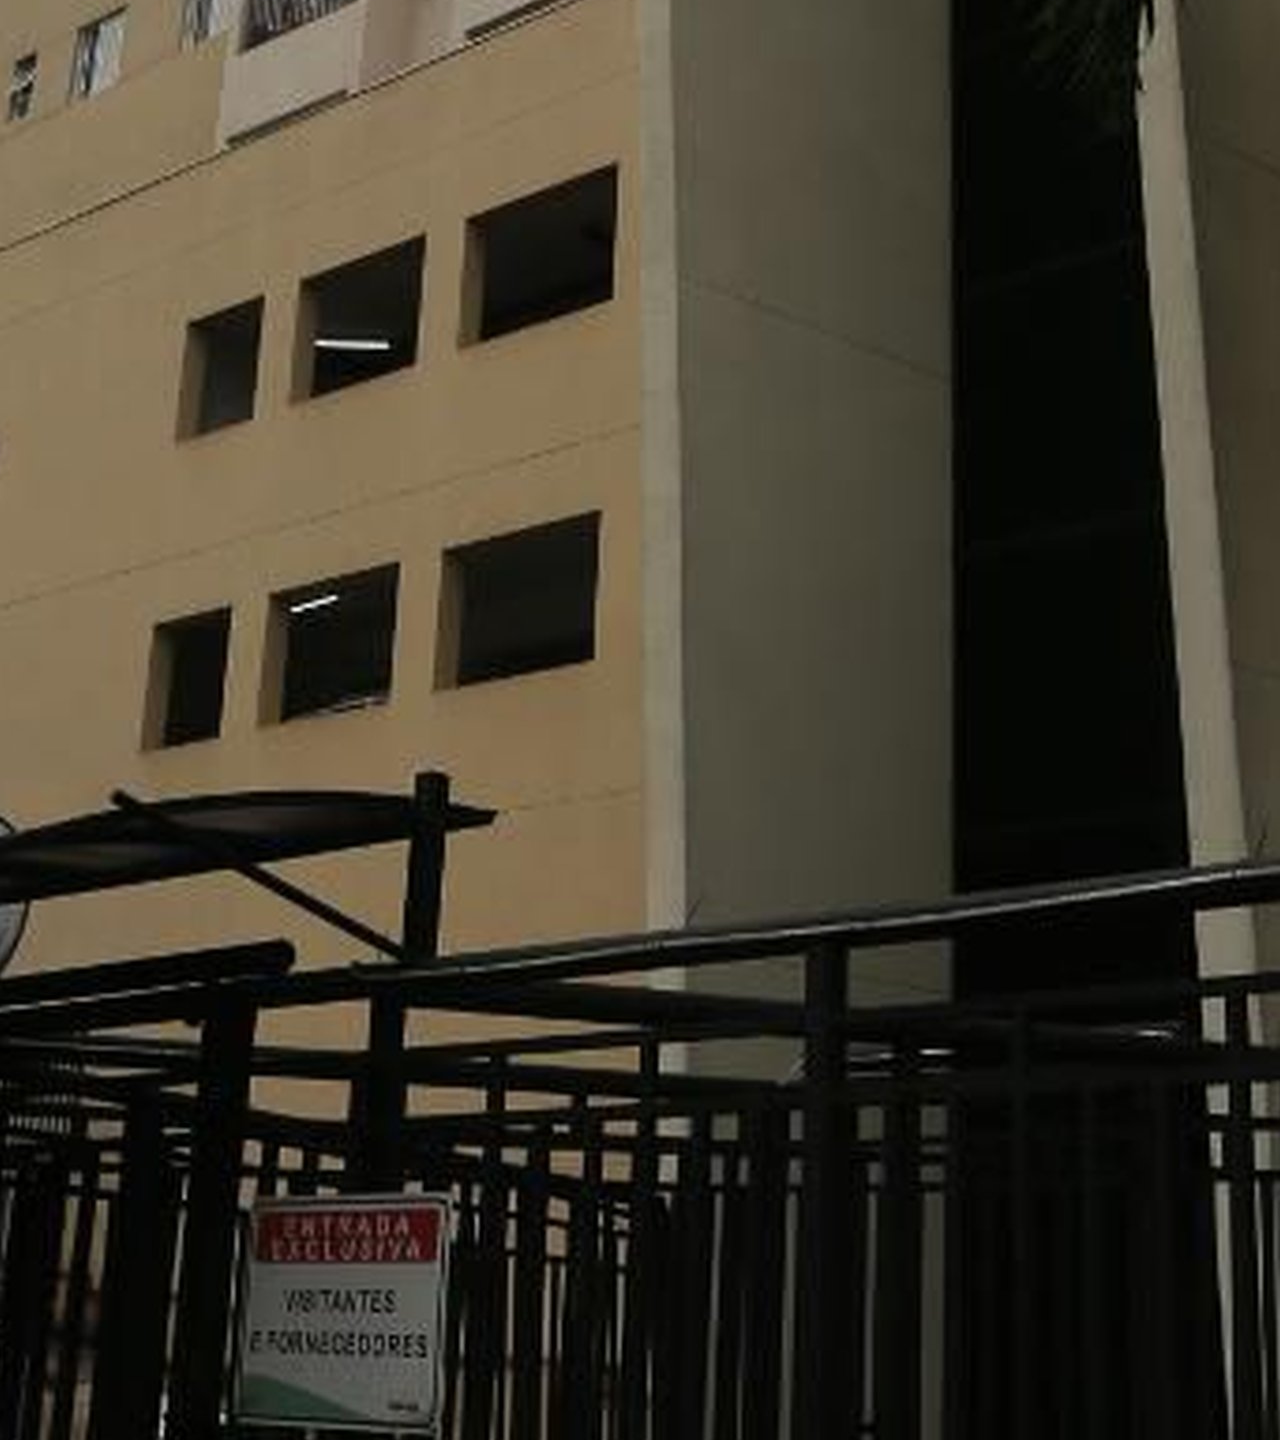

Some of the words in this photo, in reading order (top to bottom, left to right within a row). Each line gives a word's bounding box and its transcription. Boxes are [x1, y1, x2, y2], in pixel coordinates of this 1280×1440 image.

[283, 1213, 411, 1237] ENTRADA
[272, 1237, 421, 1262] EXCLUSIVA
[283, 1288, 398, 1314] VISITANTES
[267, 1330, 429, 1359] FORNECEDORES
